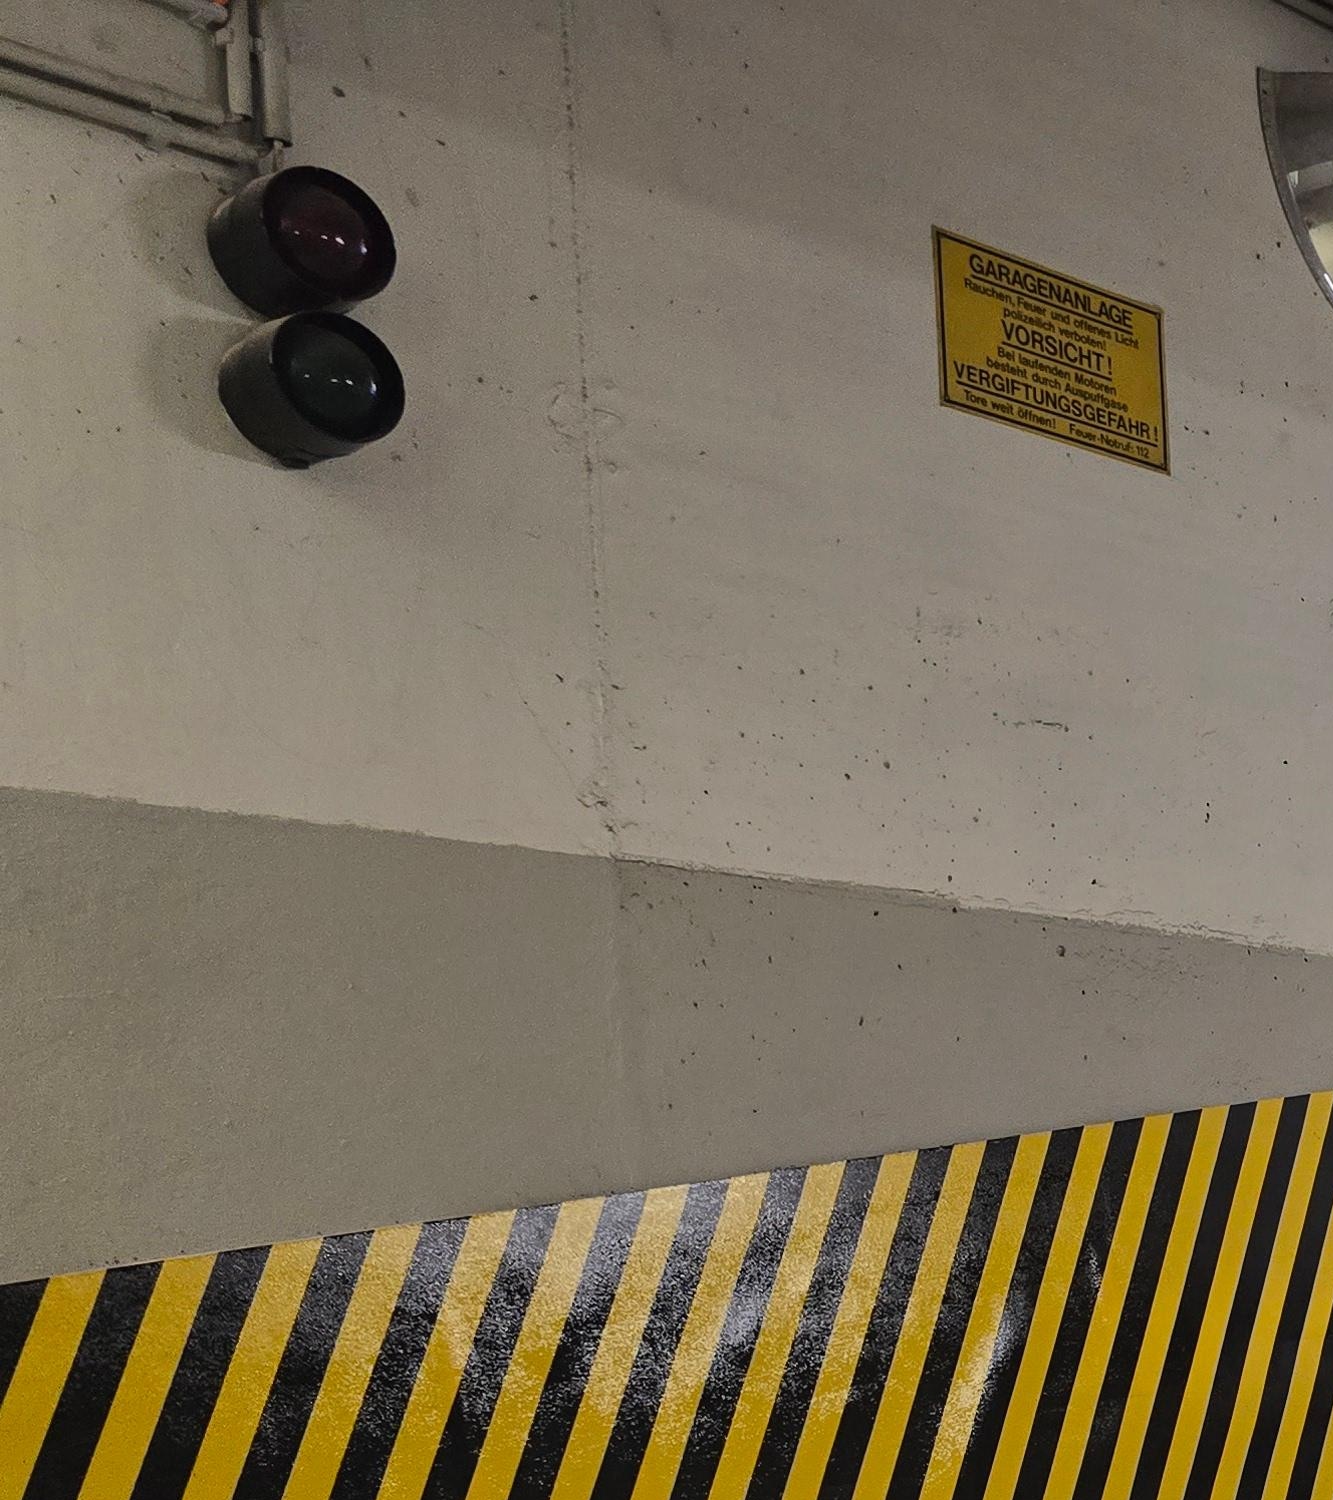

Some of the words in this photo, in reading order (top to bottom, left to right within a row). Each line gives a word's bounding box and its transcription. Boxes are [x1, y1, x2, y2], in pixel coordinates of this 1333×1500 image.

[969, 253, 1133, 329] GARAGENANLAGE
[1003, 307, 1056, 333] polizeilich
[1017, 296, 1047, 317] Feuer
[1051, 310, 1070, 325] und
[1073, 319, 1112, 340] offenes
[1114, 331, 1139, 350] Licht
[986, 355, 1027, 379] besteht
[1031, 371, 1061, 391] durch
[1064, 382, 1129, 413] Auspuffgase
[998, 346, 1016, 362] Bei
[1019, 353, 1071, 380] laufenden
[1074, 371, 1117, 396] Motoren
[963, 389, 988, 407] Tore
[991, 400, 1014, 415] weit
[1017, 406, 1056, 430] öffnen!
